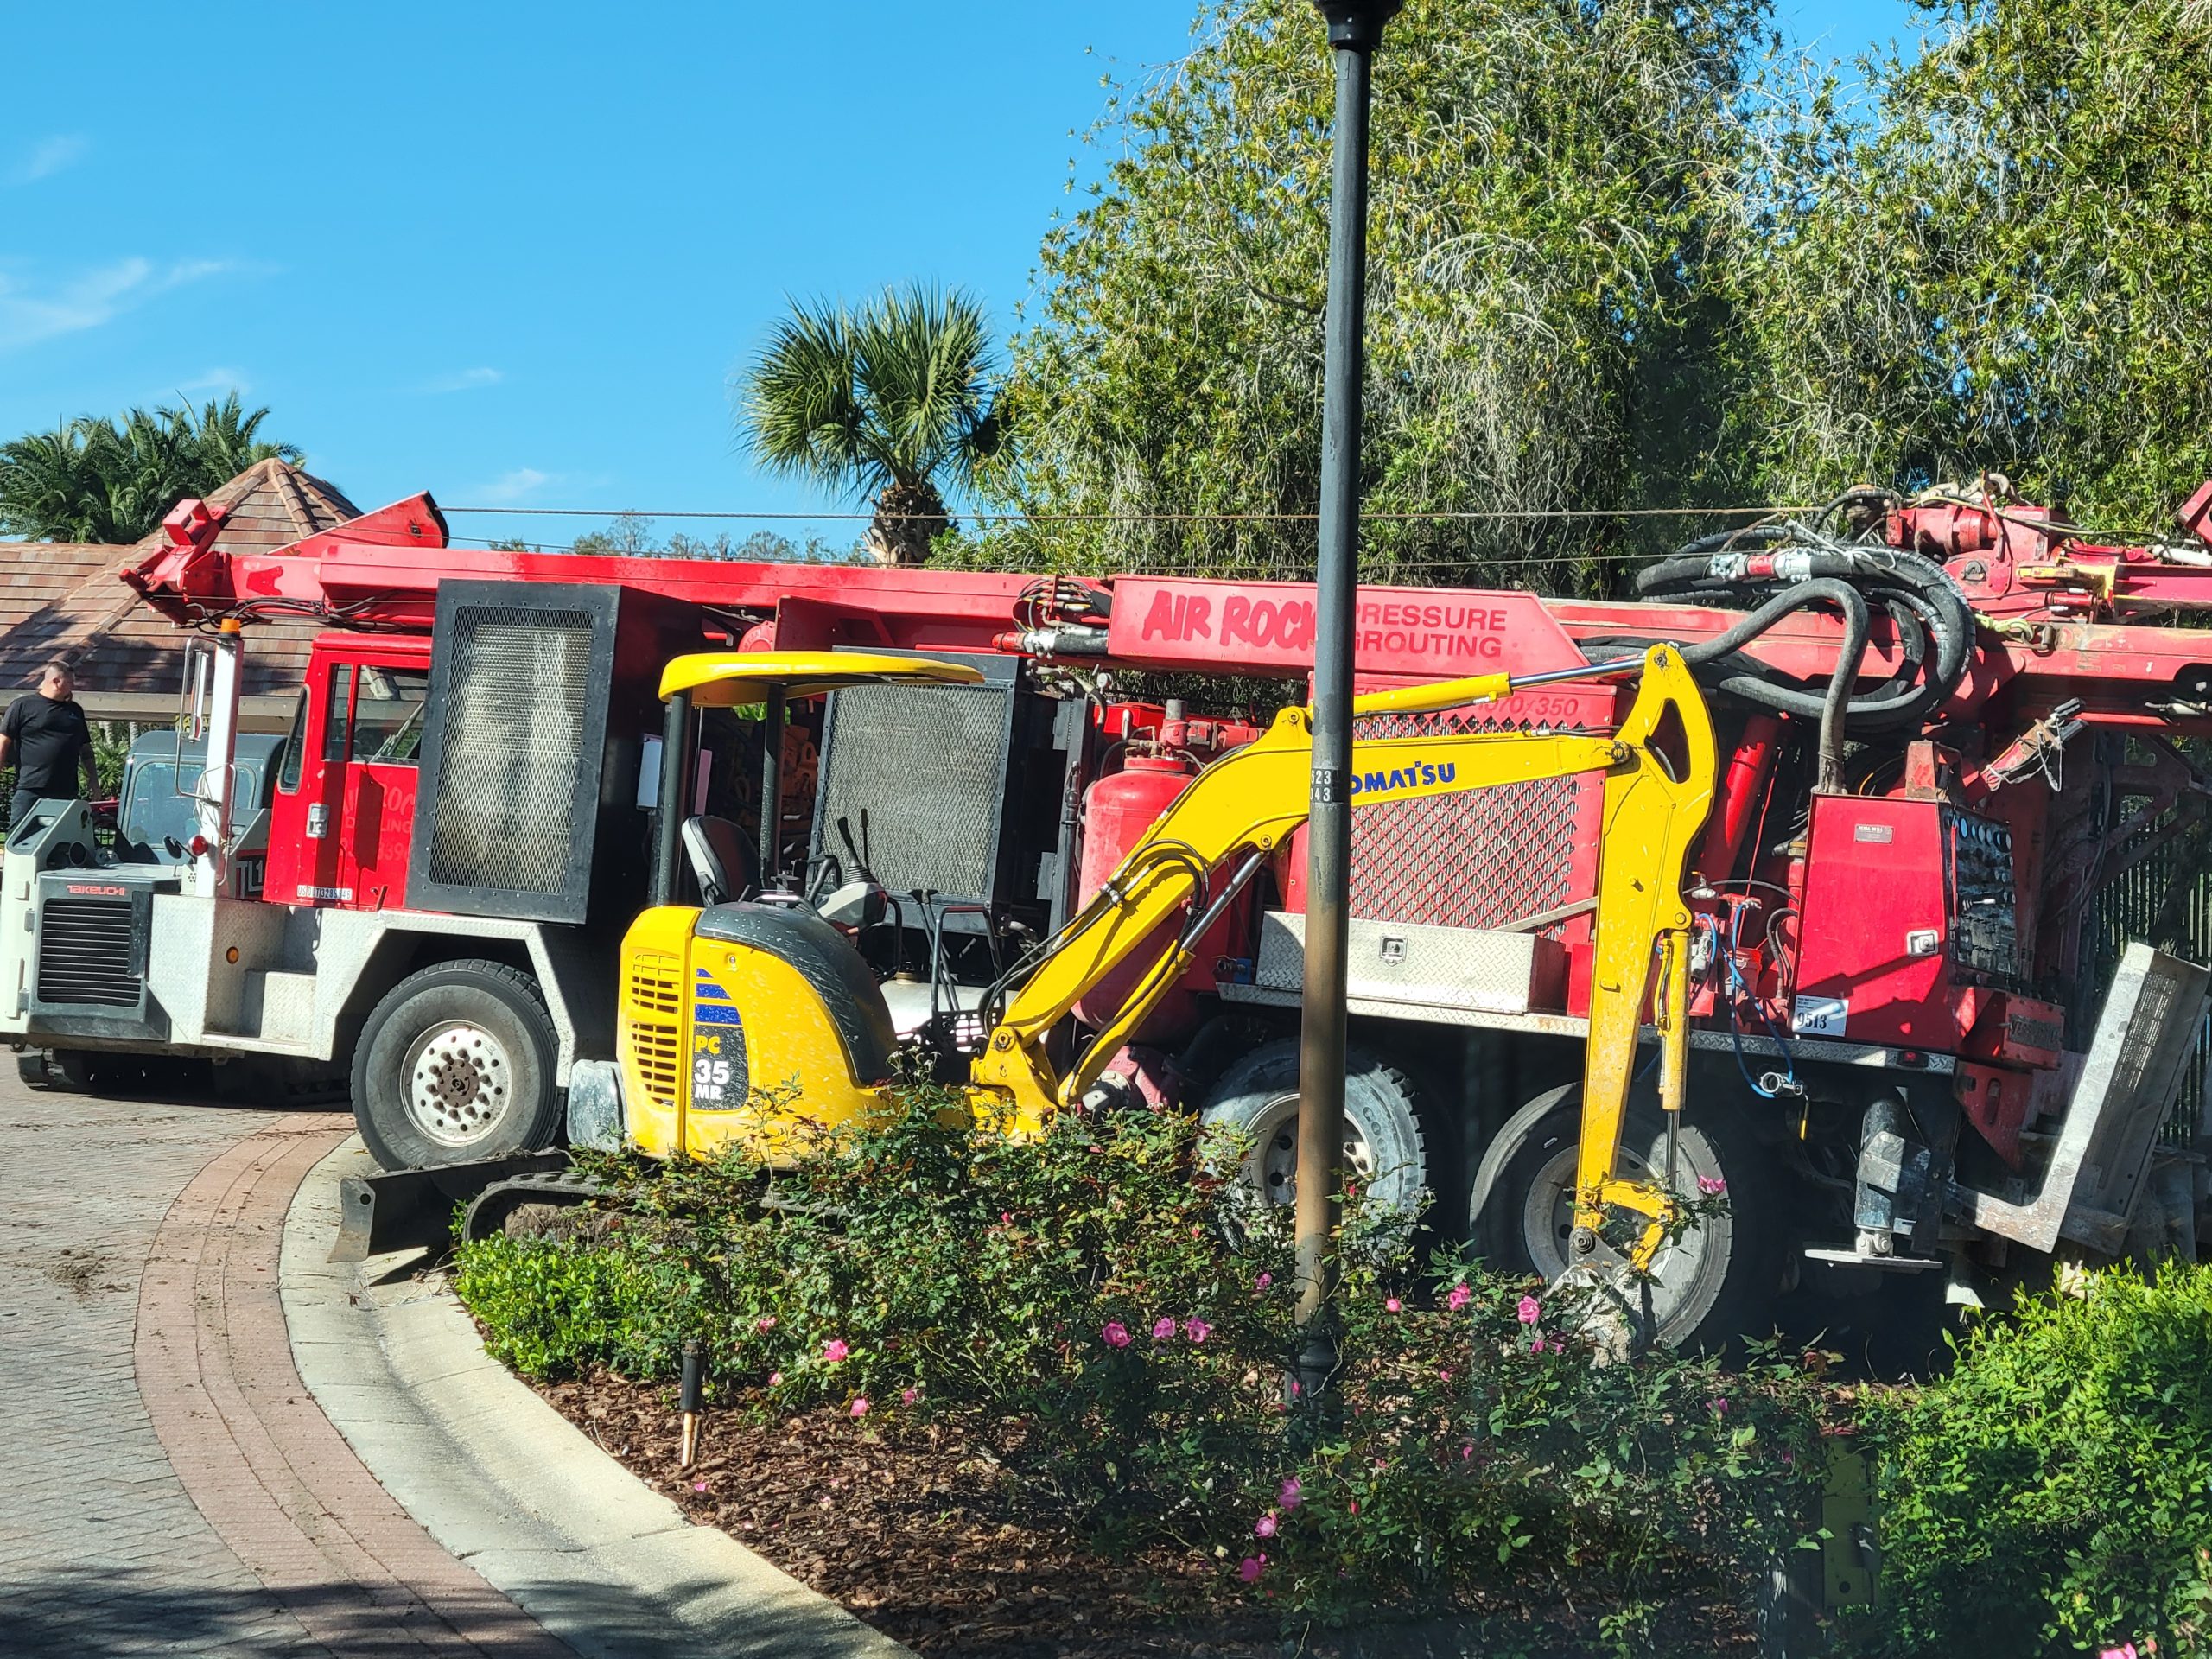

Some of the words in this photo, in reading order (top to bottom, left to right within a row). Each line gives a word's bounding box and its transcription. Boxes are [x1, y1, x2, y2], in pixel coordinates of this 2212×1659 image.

[1142, 590, 1211, 641] AIR
[1356, 603, 1508, 632] RESSURE
[1355, 631, 1502, 658] ROUTING
[1351, 760, 1455, 795] OMATSU
[1797, 1012, 1827, 1030] 9513
[694, 1035, 721, 1054] PC
[694, 1058, 730, 1084] 35
[694, 1084, 721, 1100] MR
